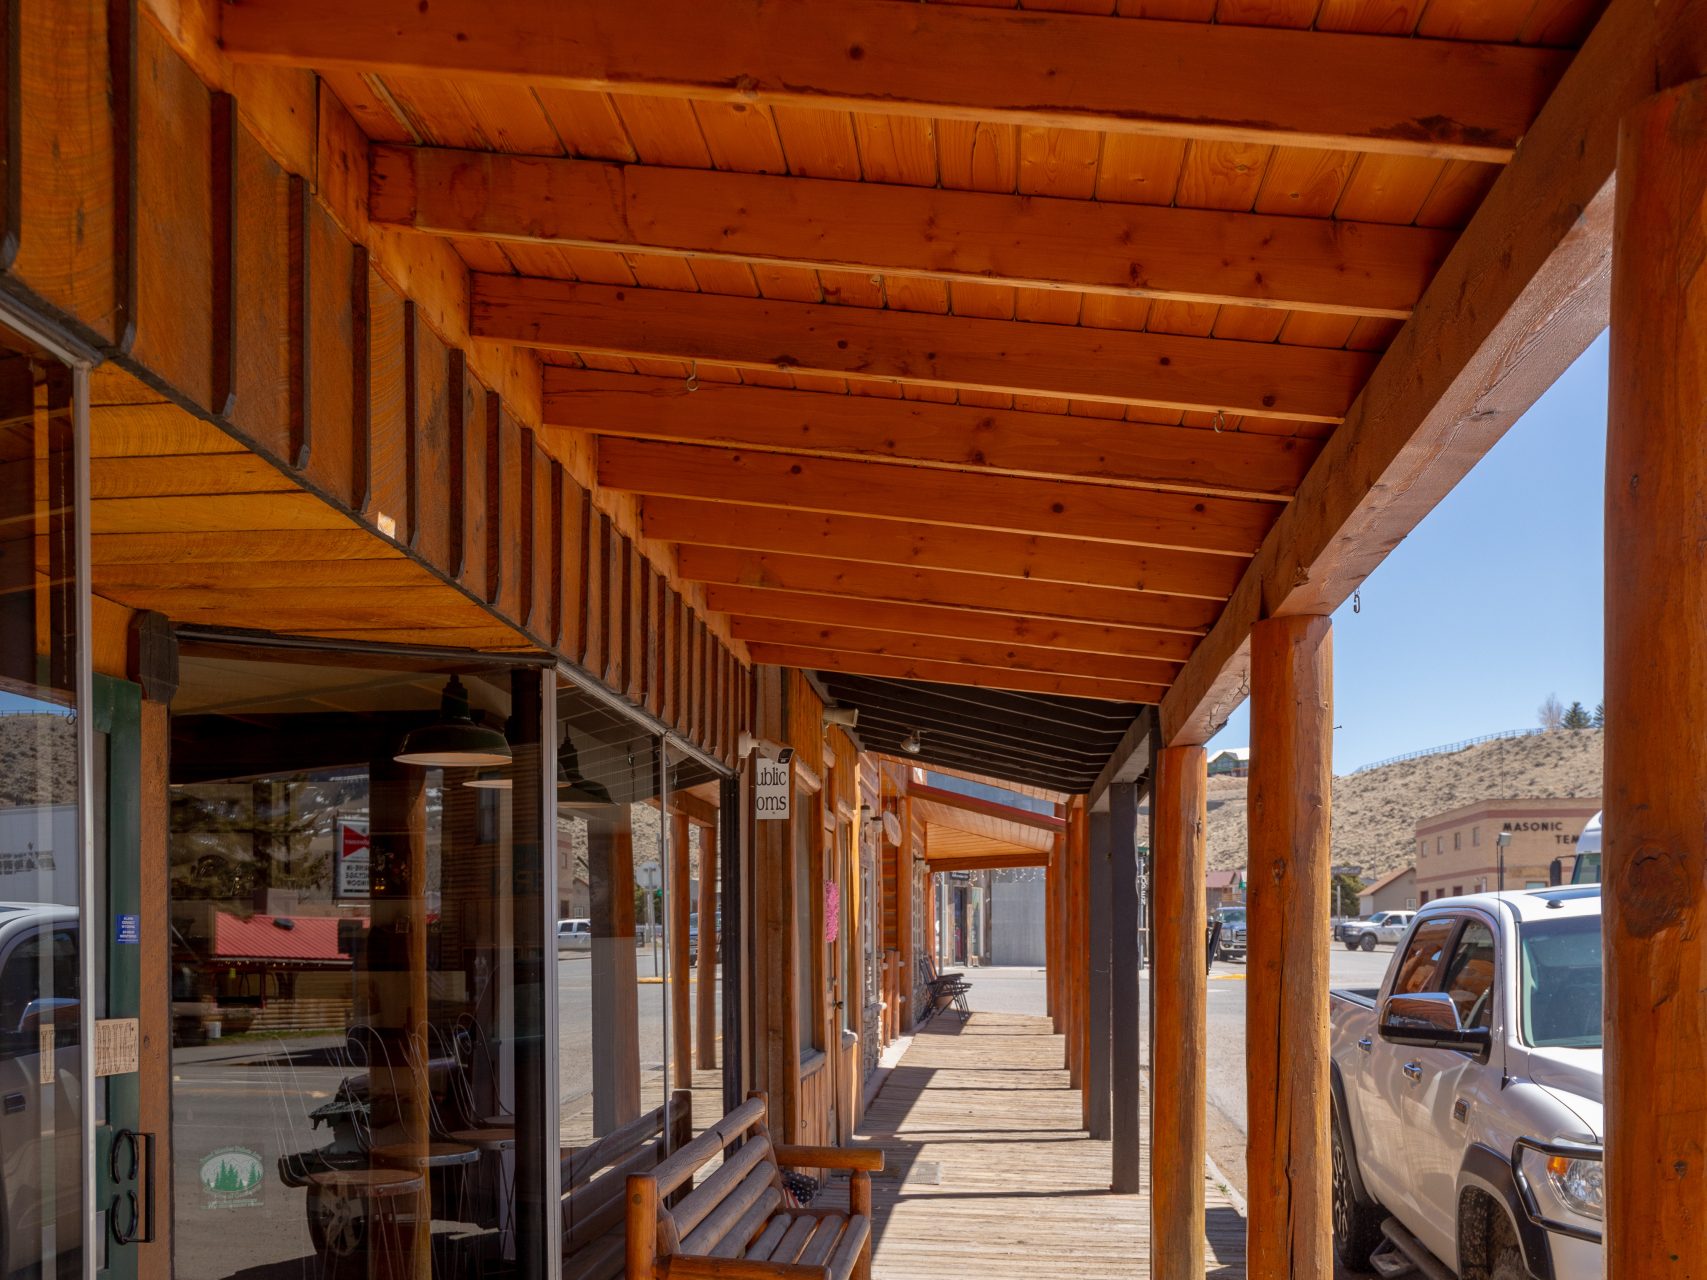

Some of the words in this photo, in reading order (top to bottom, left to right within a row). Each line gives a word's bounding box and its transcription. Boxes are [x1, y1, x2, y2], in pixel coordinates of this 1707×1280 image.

[756, 767, 787, 786] ublic
[756, 796, 787, 811] oms
[1503, 822, 1563, 832] MASONIC
[1555, 835, 1580, 845] TEM
